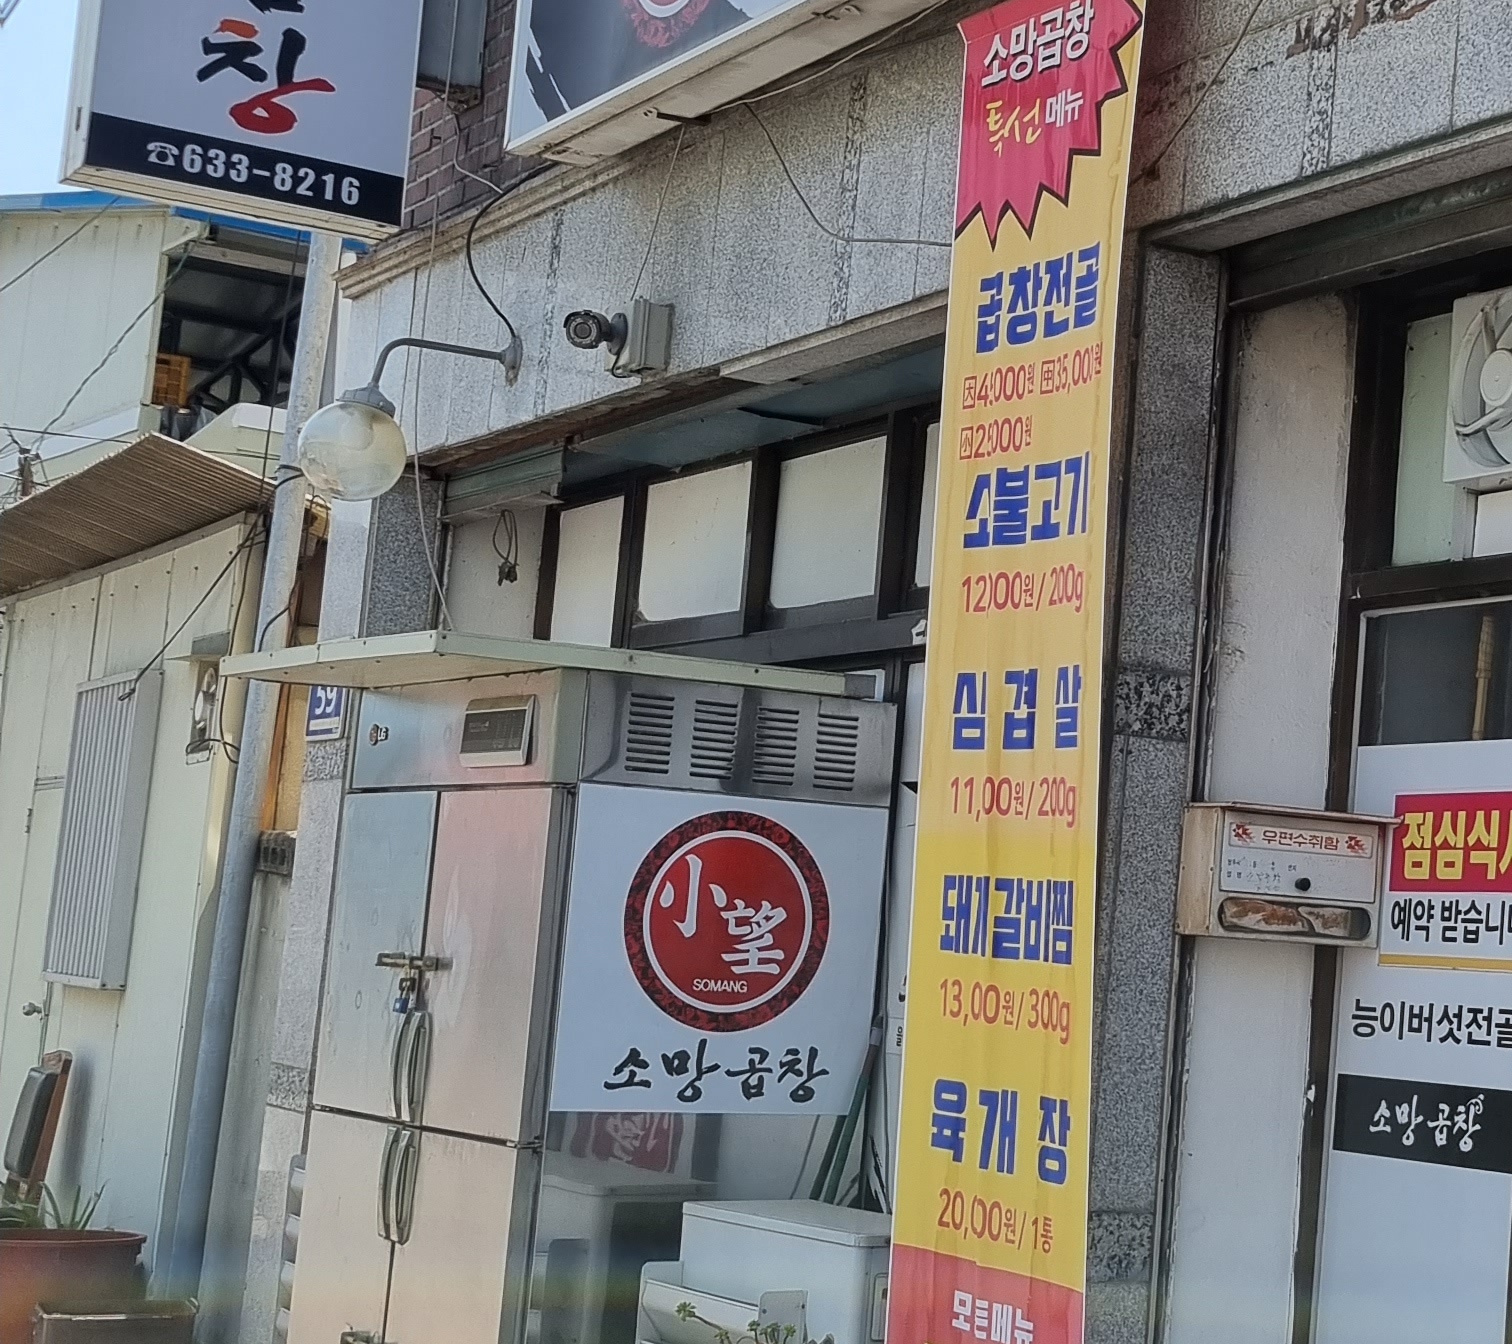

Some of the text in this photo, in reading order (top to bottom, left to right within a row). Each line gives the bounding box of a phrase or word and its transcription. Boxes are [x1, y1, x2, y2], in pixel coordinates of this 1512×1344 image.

[985, 89, 1085, 158] 특선 메뉴
[181, 141, 362, 206] 633-8216
[975, 240, 1102, 355] 곱창전골
[963, 450, 1091, 549] 소불고기
[314, 686, 338, 716] 59
[1262, 829, 1340, 851] 우편수취함
[939, 874, 1074, 966] 돼지갈비찜
[1390, 898, 1435, 943] 예약
[692, 978, 748, 994] SOMANG
[930, 1078, 1071, 1186] 육개장
